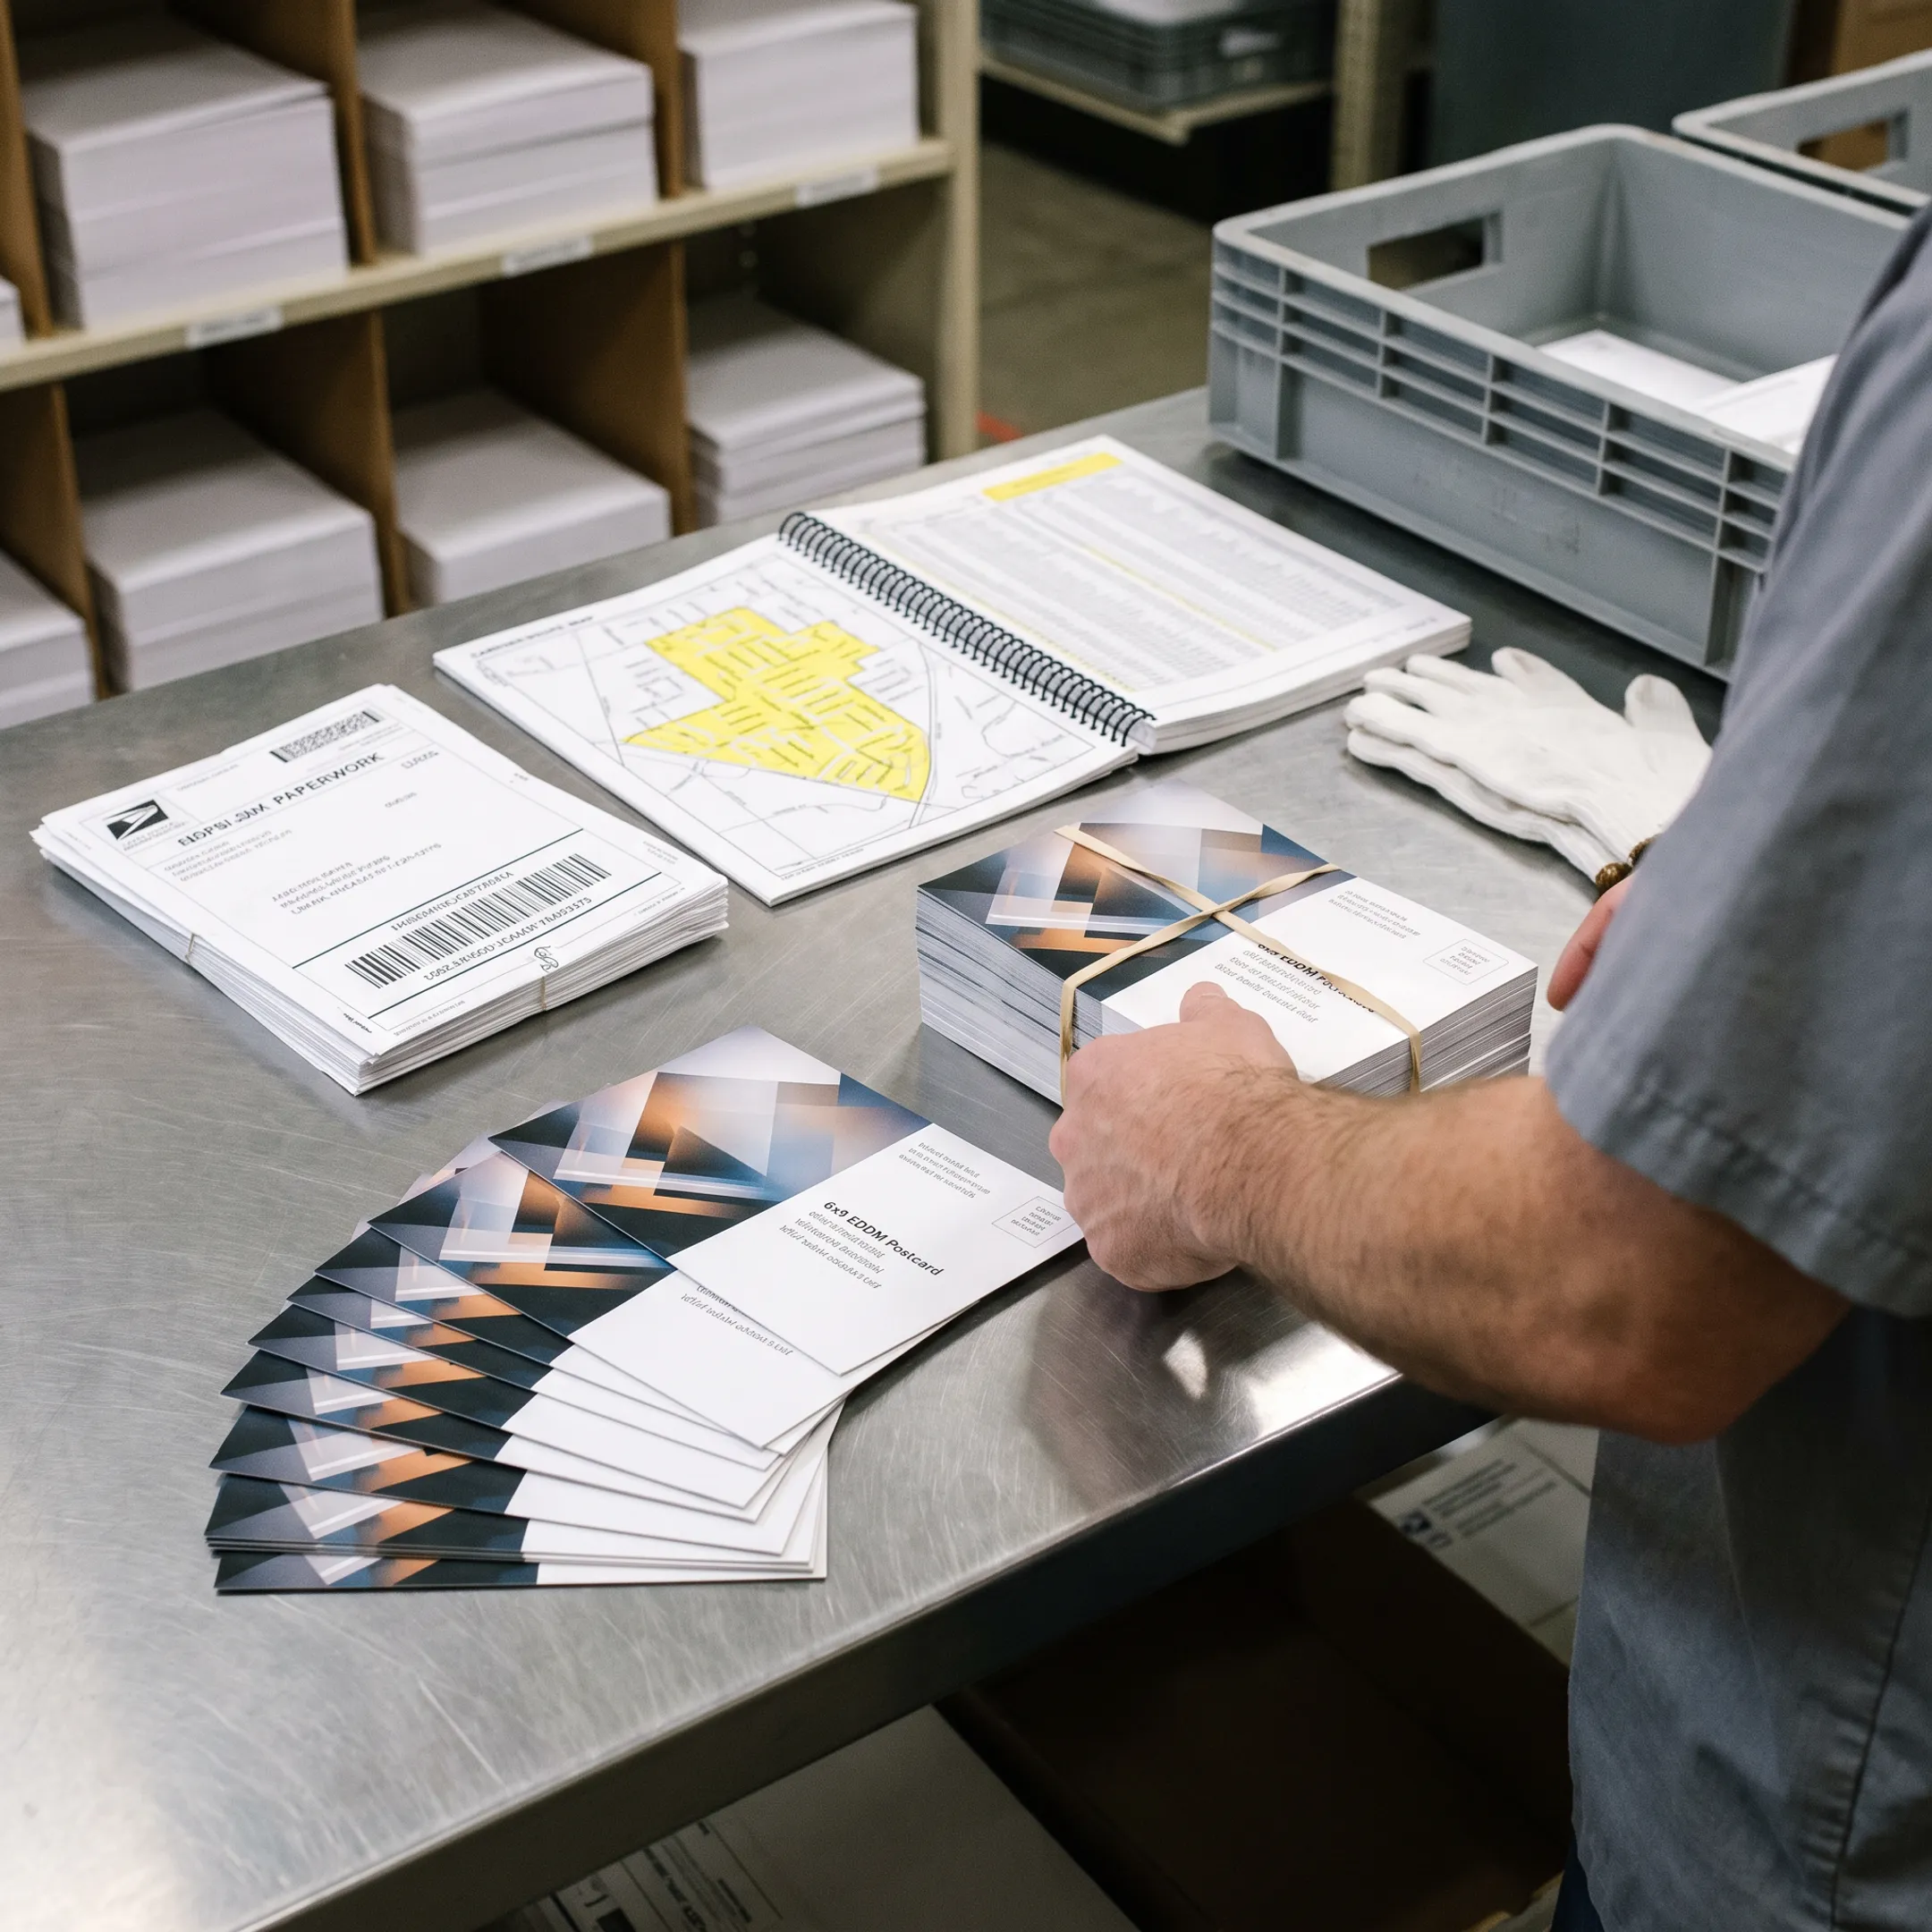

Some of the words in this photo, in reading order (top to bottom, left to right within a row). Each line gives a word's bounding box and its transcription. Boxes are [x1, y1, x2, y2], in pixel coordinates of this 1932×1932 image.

[272, 751, 385, 806] PAPERWORK
[823, 1200, 849, 1218] 6x9
[846, 1216, 888, 1242] EDDM
[886, 1240, 945, 1276] Postcard
